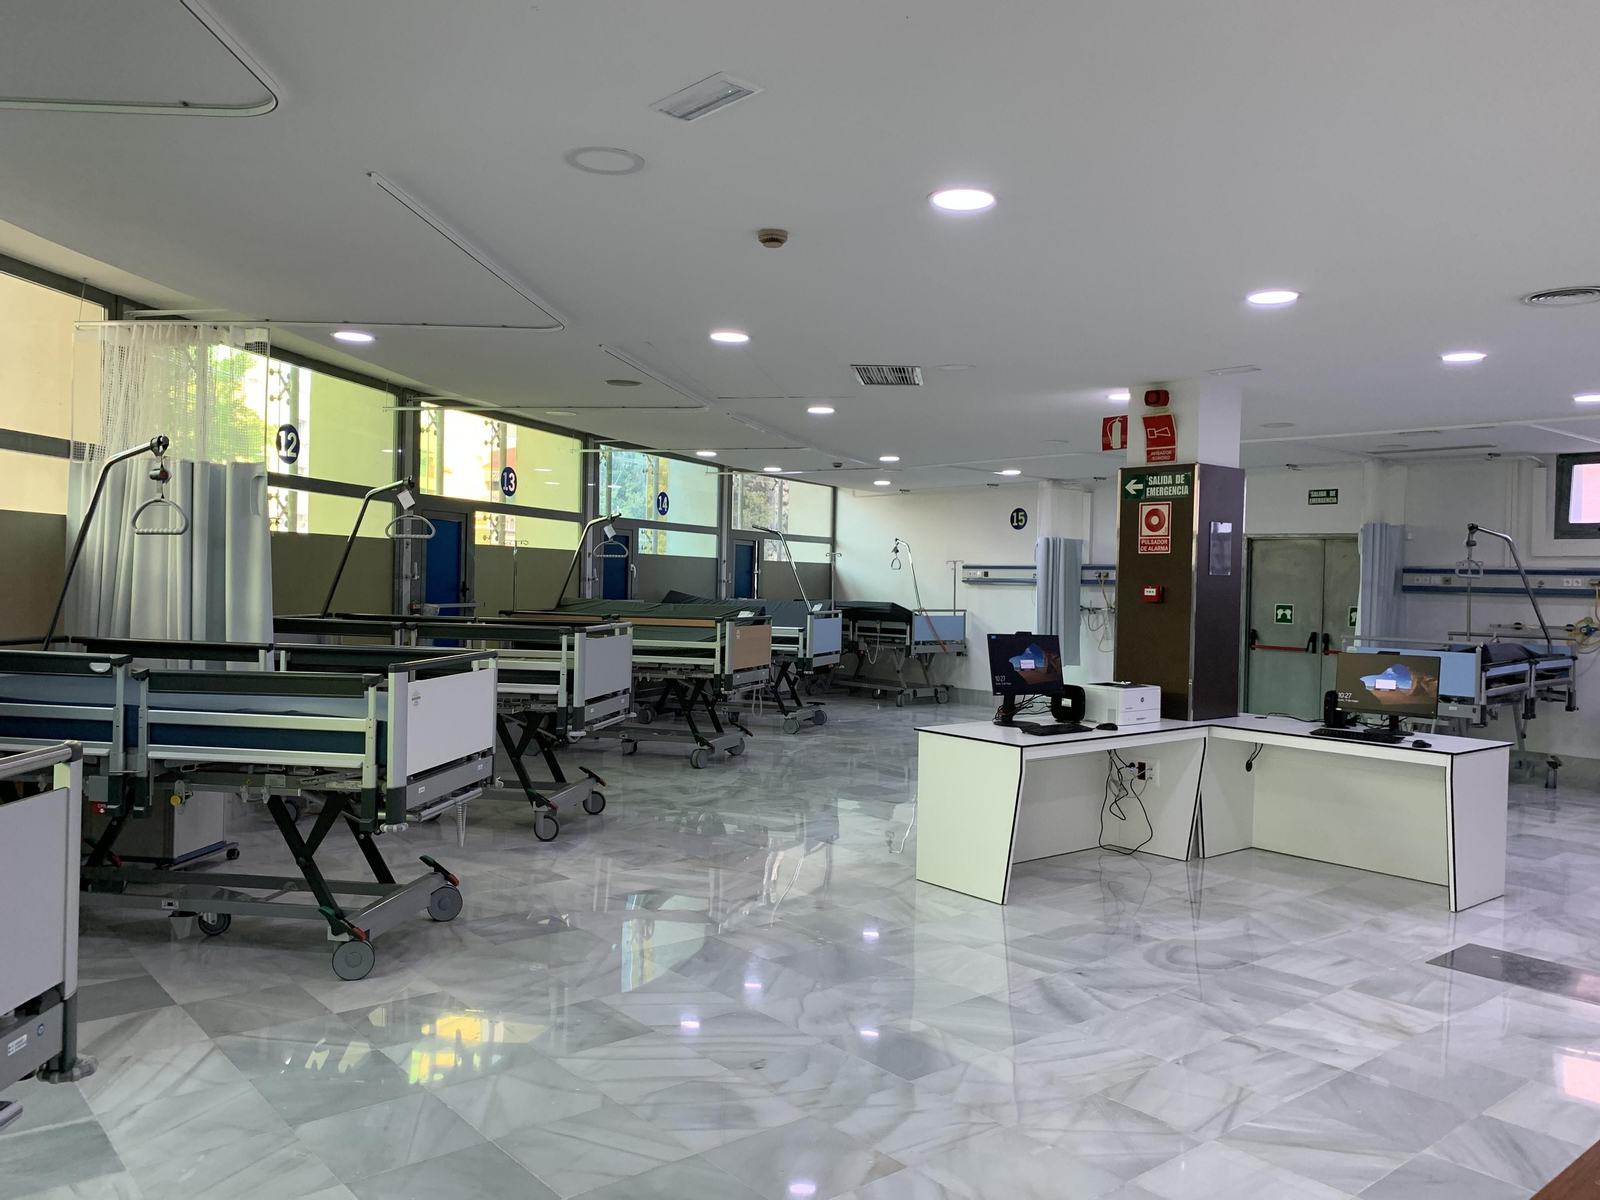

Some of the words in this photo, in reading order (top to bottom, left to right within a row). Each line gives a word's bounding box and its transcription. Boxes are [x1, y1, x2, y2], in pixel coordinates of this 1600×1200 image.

[279, 430, 297, 457] 12
[503, 472, 515, 492] 13
[1148, 475, 1173, 486] SALIDA
[1175, 474, 1185, 484] DE
[1146, 485, 1189, 497] EMERGENCIA
[658, 495, 668, 512] 14
[1012, 511, 1026, 526] 15
